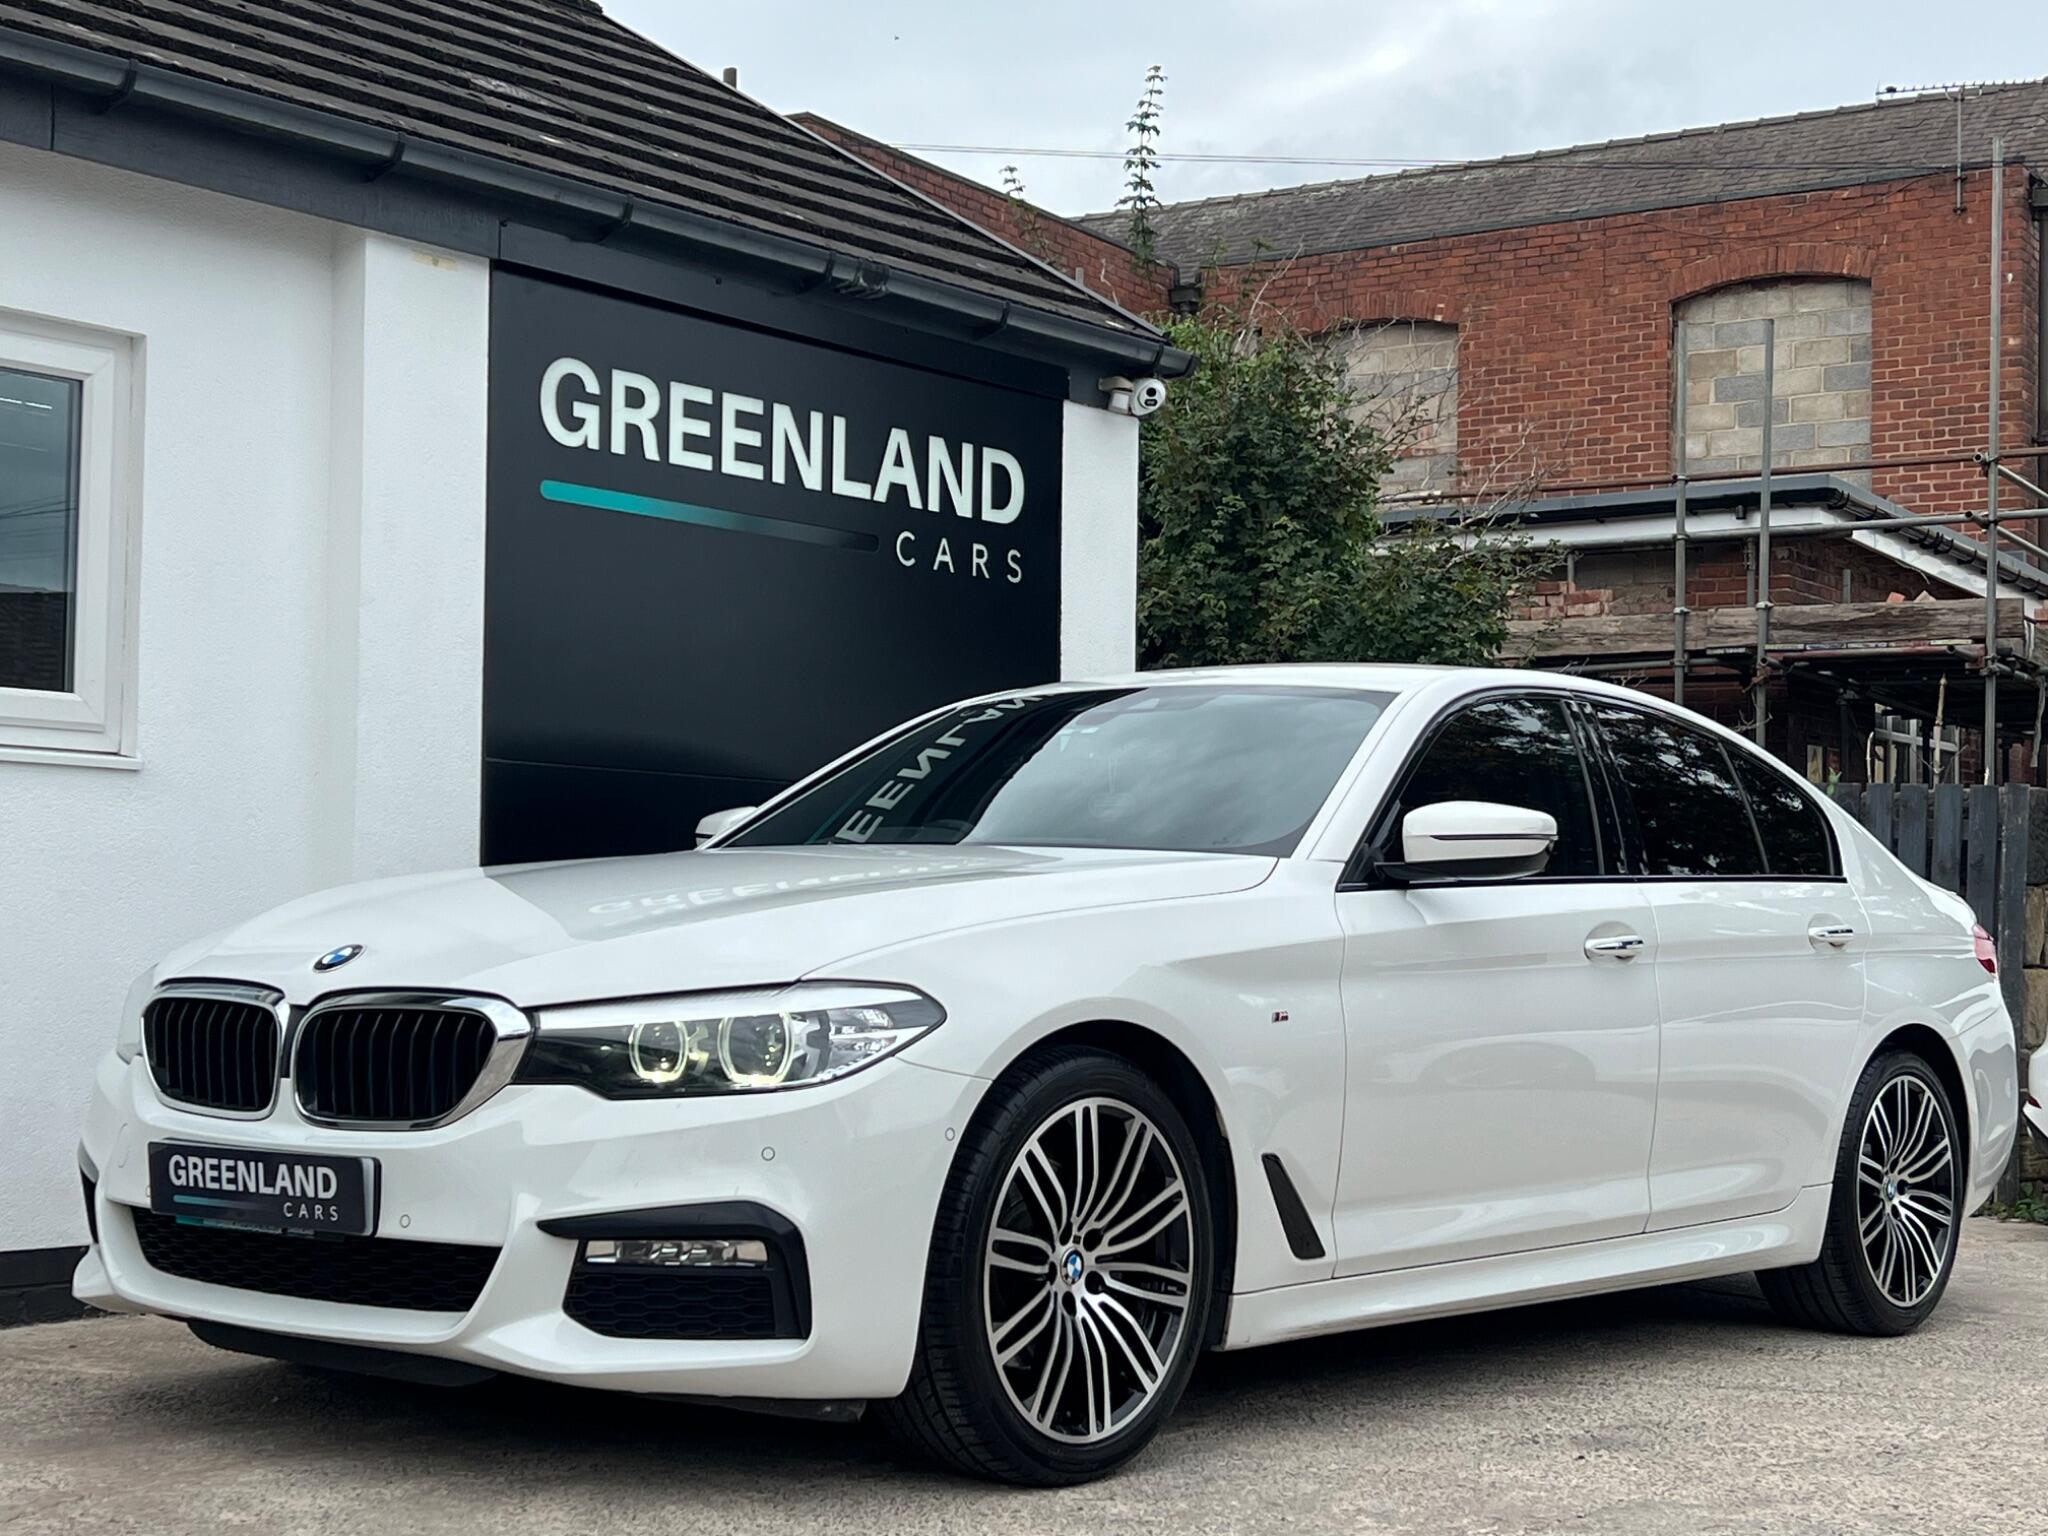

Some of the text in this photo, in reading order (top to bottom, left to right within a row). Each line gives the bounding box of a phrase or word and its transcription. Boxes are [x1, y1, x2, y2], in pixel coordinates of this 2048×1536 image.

[539, 357, 1025, 525] GREENLAND
[896, 531, 1023, 584] CARS
[168, 1154, 338, 1199] GREENLAND
[283, 1201, 339, 1222] CARS
